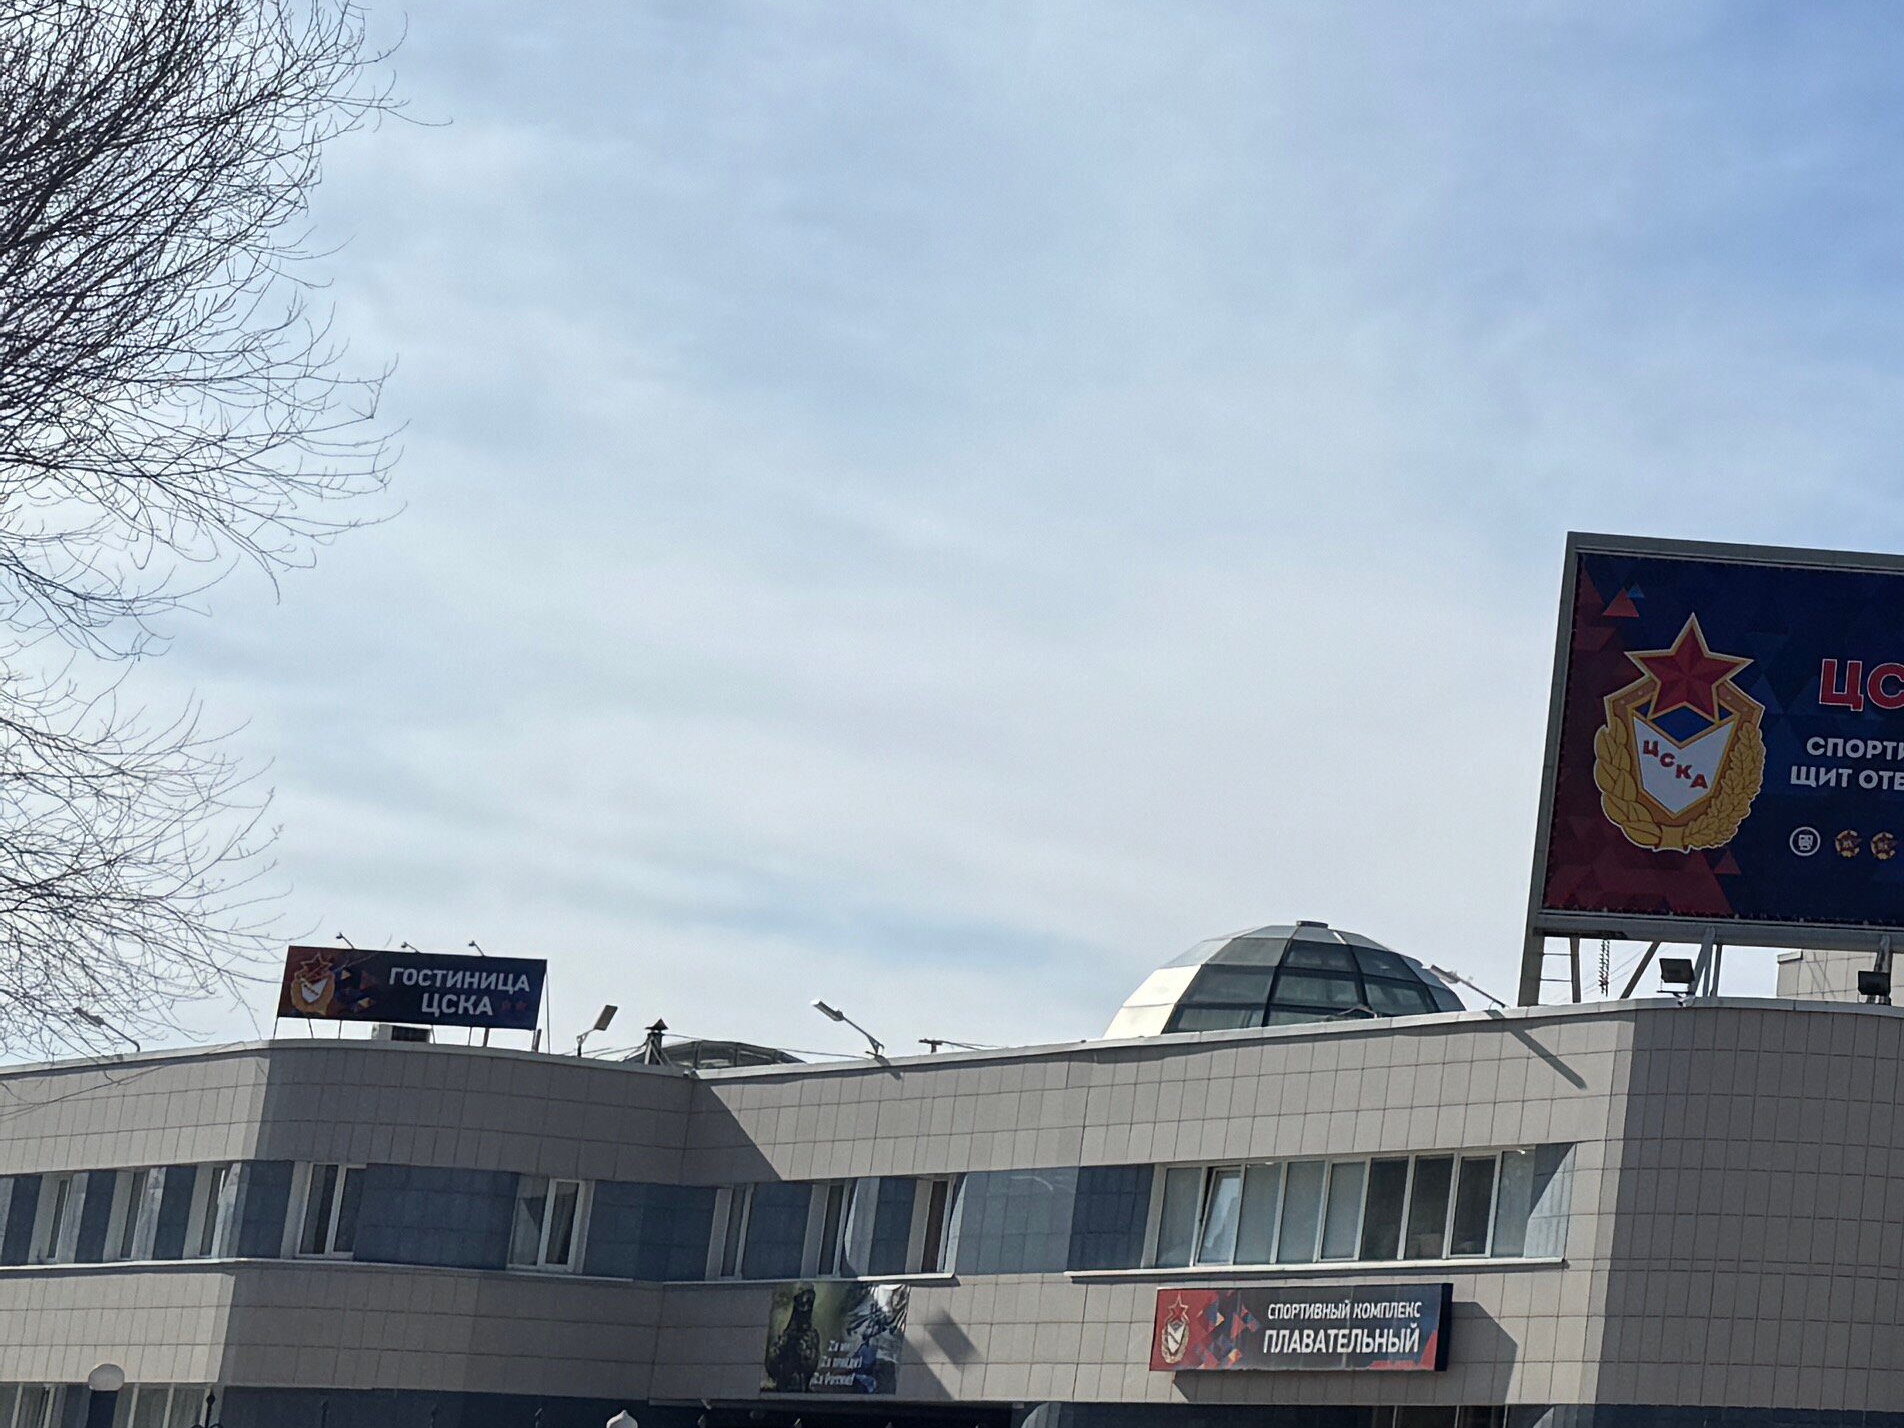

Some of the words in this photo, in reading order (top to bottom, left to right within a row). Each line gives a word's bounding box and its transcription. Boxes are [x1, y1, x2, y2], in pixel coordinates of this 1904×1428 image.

[1643, 740, 1708, 789] ЦСКА
[1790, 765, 1852, 788] ЩИТ
[389, 967, 531, 995] ГОСТИНИЦА
[421, 994, 493, 1017] ЦСКА
[1268, 1299, 1351, 1320] СПОРТИВНЫЙ
[1353, 1301, 1422, 1319] КОМПЛЕКС
[1263, 1322, 1420, 1353] ПЛАВАТЕЛЬНЫЙ
